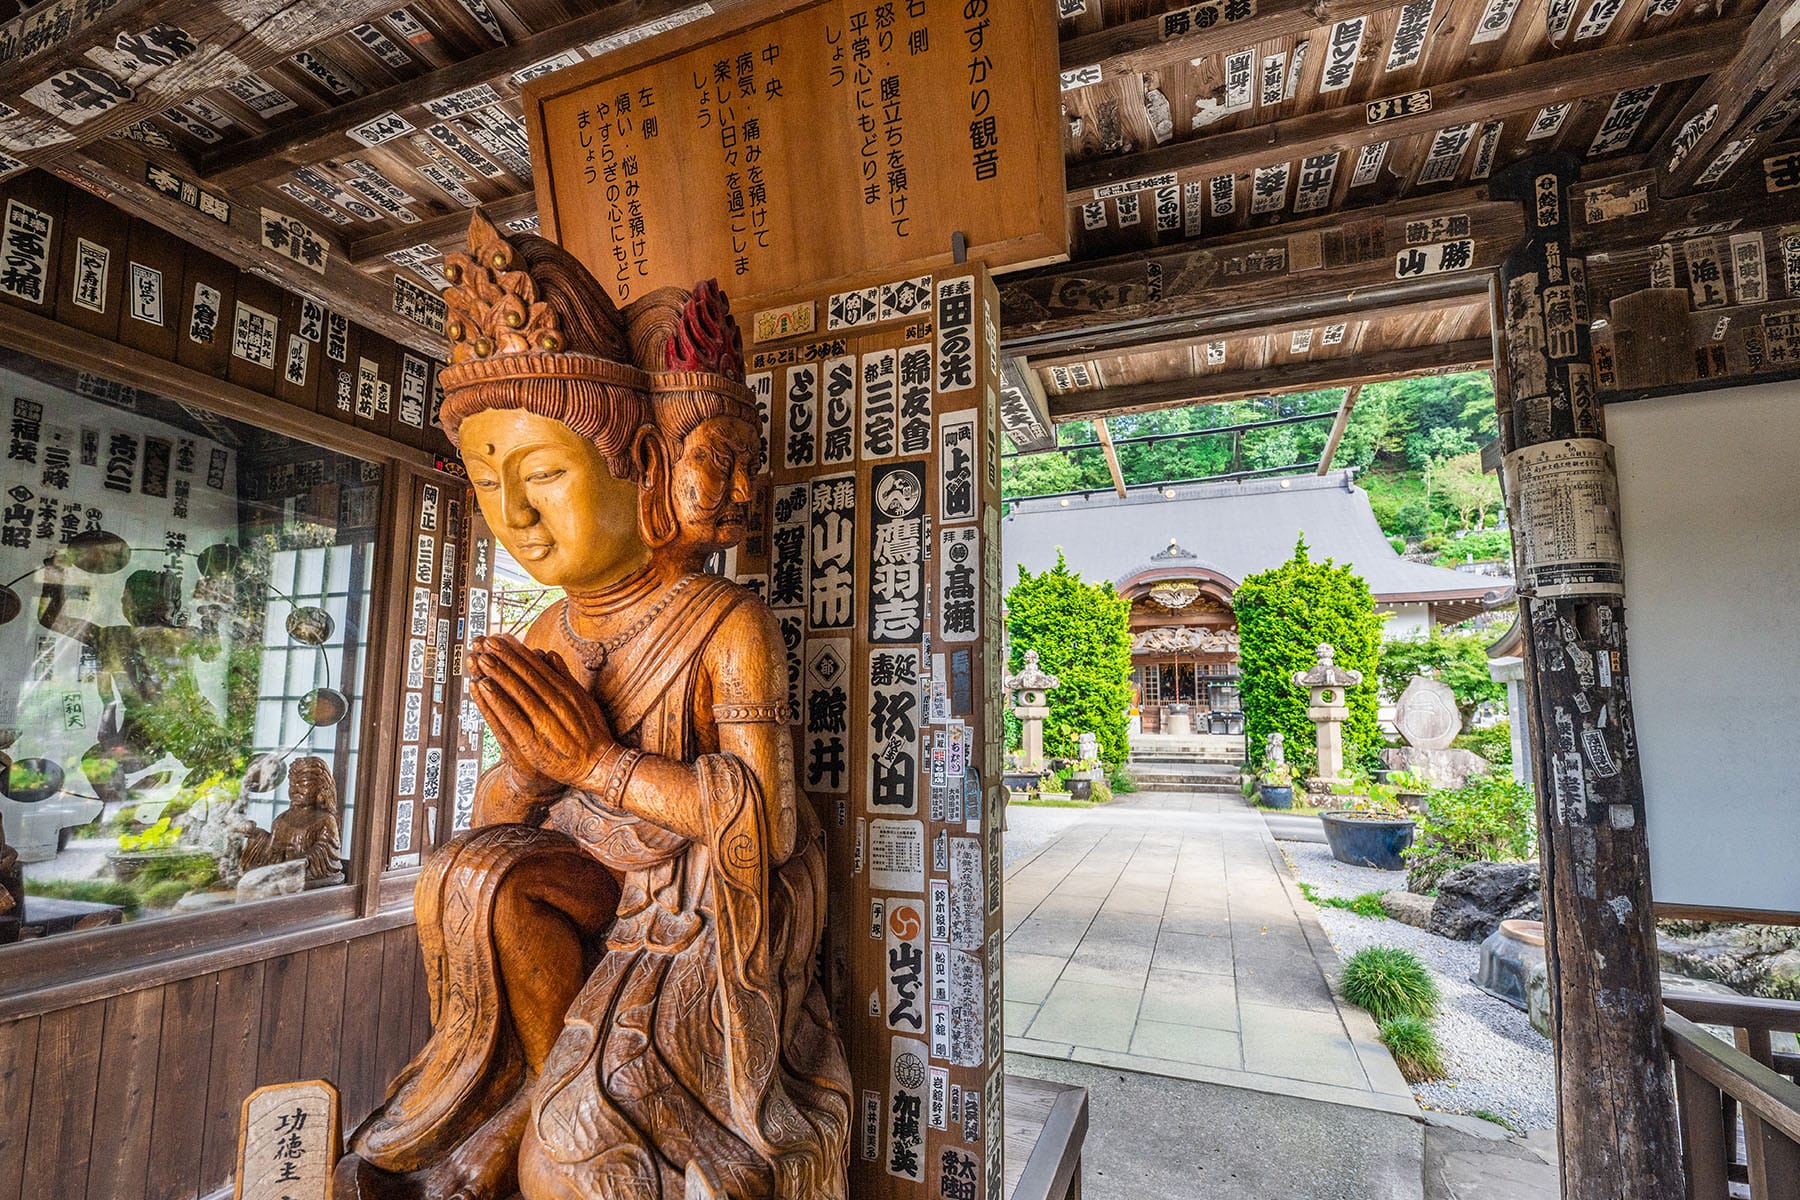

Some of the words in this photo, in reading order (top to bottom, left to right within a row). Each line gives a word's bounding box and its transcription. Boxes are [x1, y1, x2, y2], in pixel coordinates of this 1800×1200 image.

[692, 70, 711, 129] しょう
[763, 43, 783, 100] 中央
[825, 26, 844, 88] しょう
[577, 110, 597, 184] ましょう
[638, 87, 659, 140] 左側
[849, 13, 881, 204] 平常心にもどりま
[596, 102, 630, 301] やすらぎの心にもどり
[714, 62, 750, 276] 楽しい日々を過ごしま
[872, 518, 921, 640] 鷹羽志
[807, 686, 848, 788] 鯨井
[888, 943, 923, 1030] 山でん
